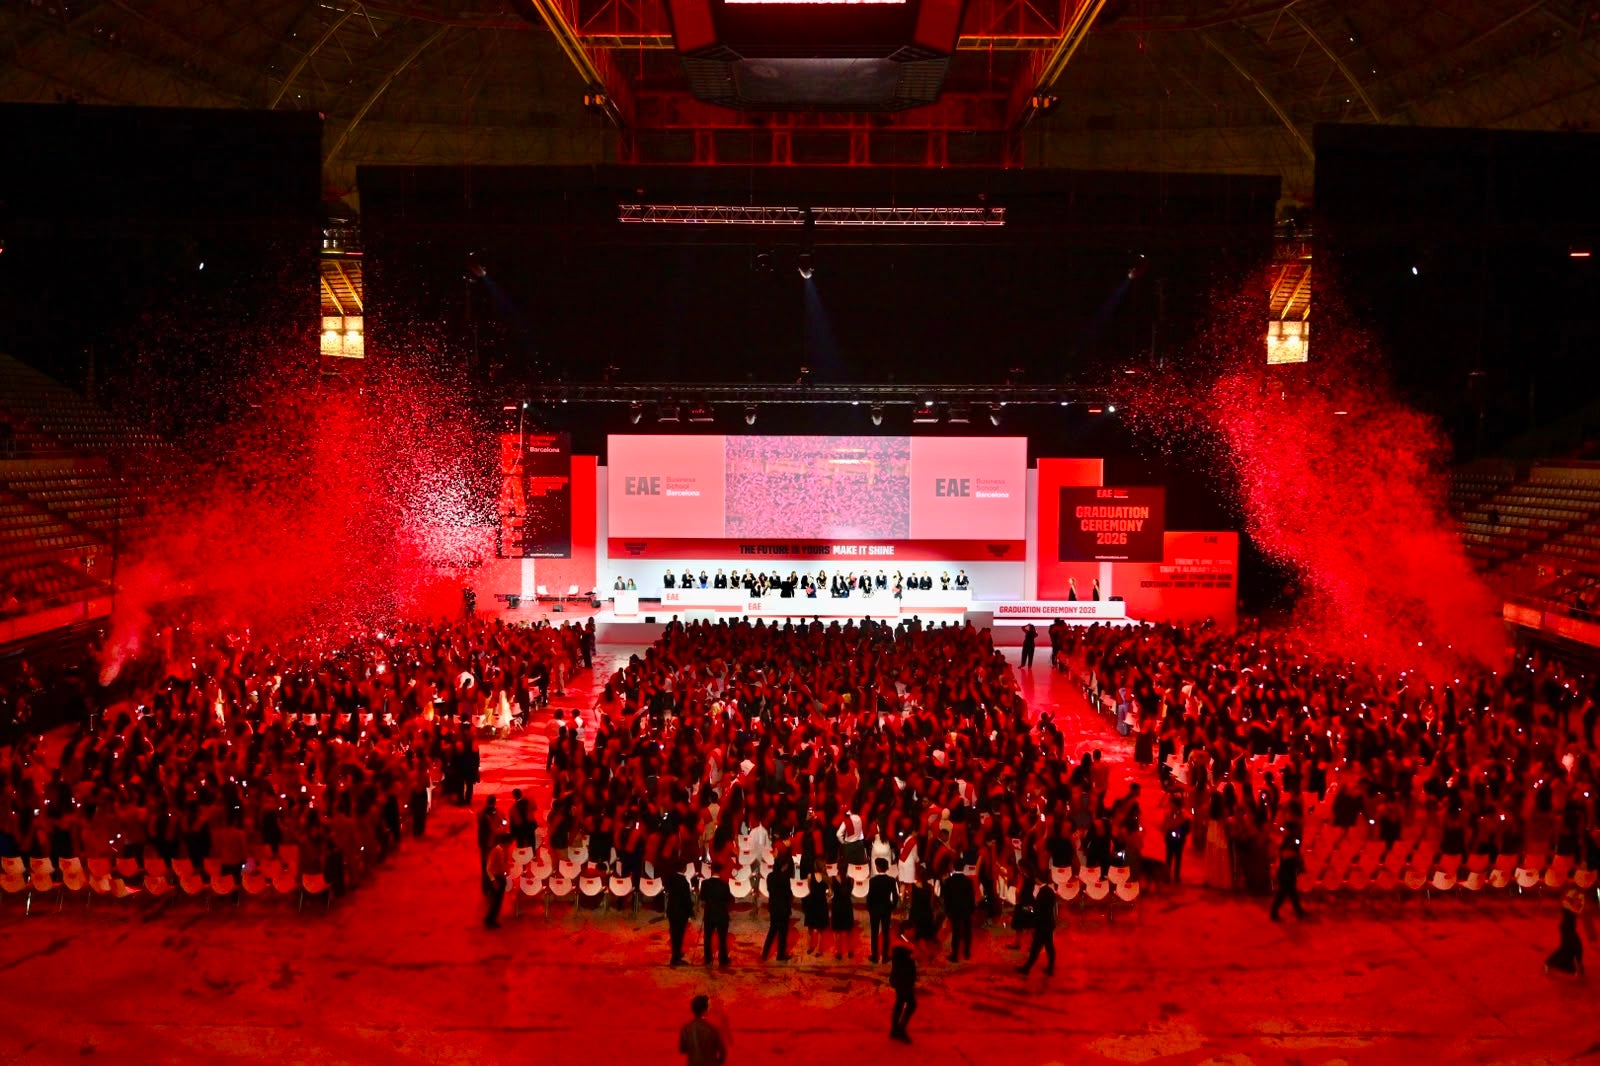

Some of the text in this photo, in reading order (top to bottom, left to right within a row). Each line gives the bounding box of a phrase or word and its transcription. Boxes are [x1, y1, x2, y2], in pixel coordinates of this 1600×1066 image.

[625, 476, 661, 496] EAE
[935, 478, 970, 497] EAE
[666, 489, 700, 497] Barcelona
[1096, 489, 1113, 498] EAE
[1076, 506, 1149, 519] GRADUATION
[1081, 519, 1144, 532] CEREMONY
[1096, 532, 1127, 545] 2026
[740, 545, 756, 555] THE
[757, 545, 789, 555] FUTURE
[802, 545, 830, 555] YOURS
[833, 545, 857, 555] MAKE
[858, 545, 868, 555] IT
[868, 545, 895, 556] SHINE
[666, 593, 679, 601] EAE
[748, 602, 762, 610] EAE
[999, 606, 1096, 614] GRADUATION CEREMONY 2026
